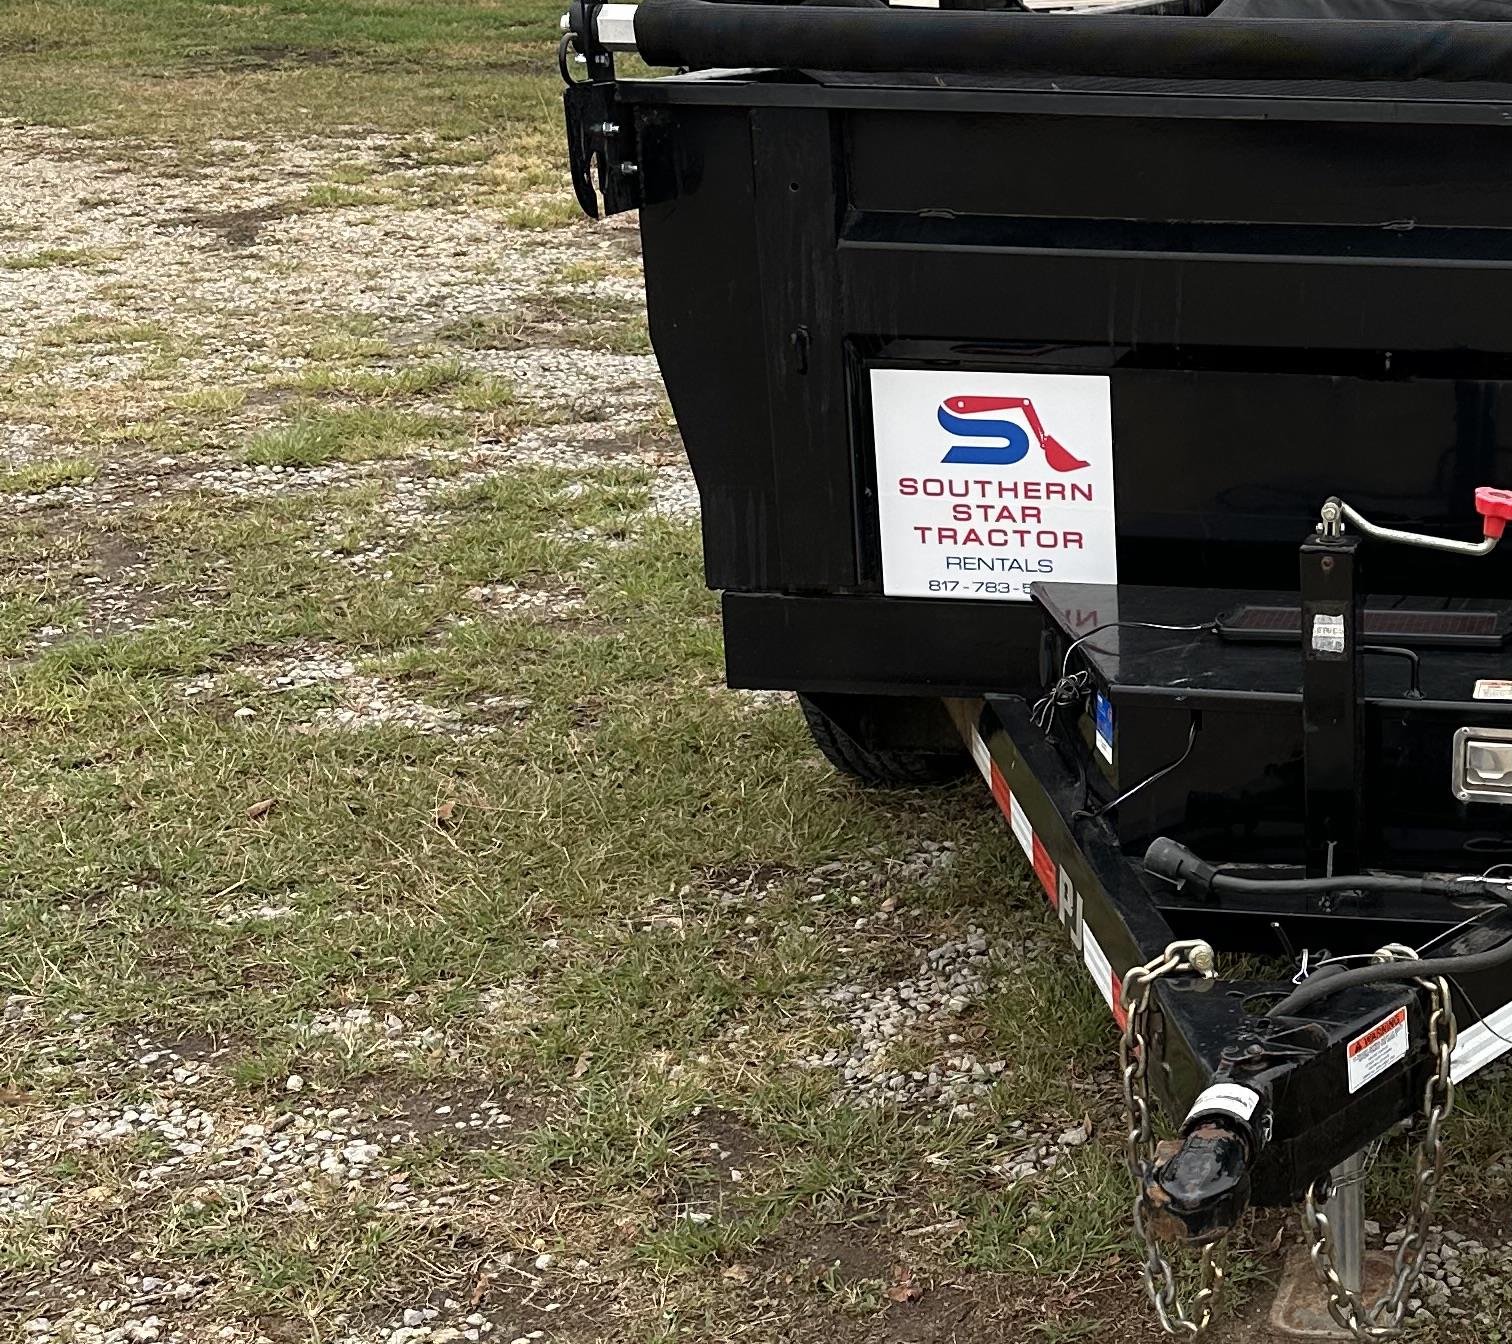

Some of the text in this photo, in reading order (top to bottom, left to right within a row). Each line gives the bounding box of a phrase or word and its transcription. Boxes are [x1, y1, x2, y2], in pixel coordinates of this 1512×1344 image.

[898, 477, 1093, 502] SOUTHERN
[952, 503, 1042, 524] STAR
[913, 526, 1084, 550] TRACTOR
[946, 555, 1054, 574] RENTALS
[1058, 863, 1083, 951] PJ
